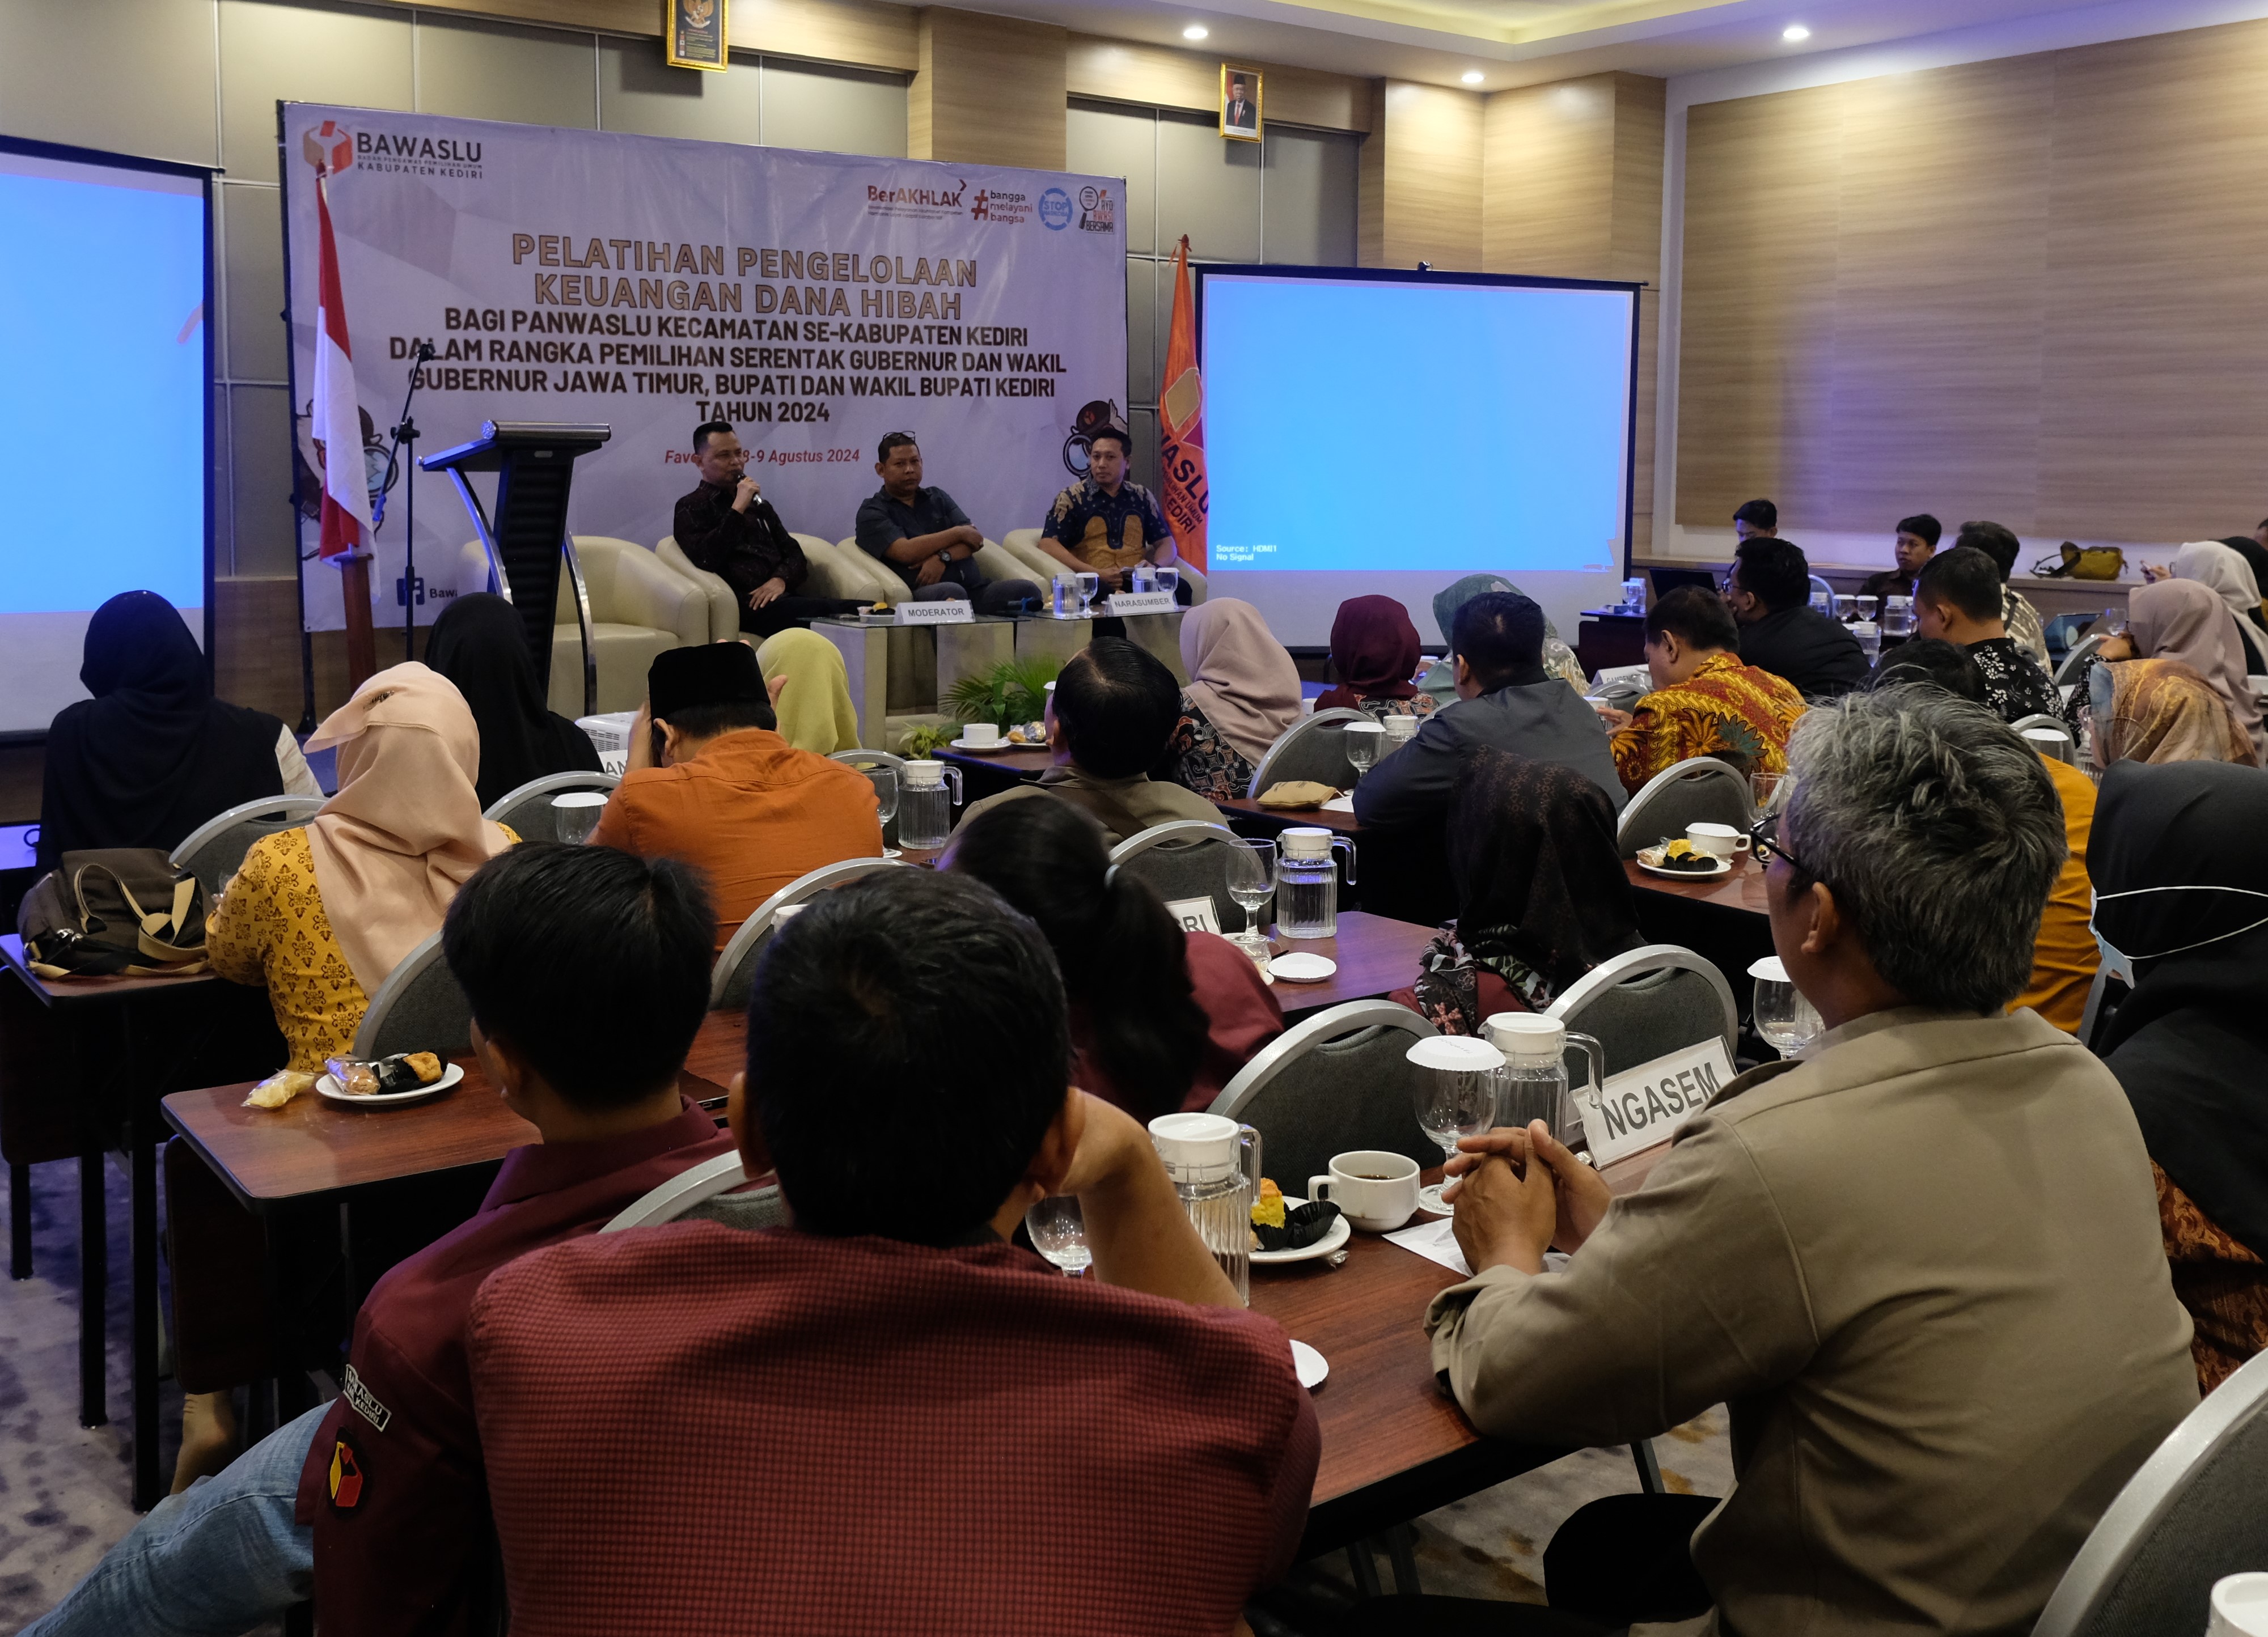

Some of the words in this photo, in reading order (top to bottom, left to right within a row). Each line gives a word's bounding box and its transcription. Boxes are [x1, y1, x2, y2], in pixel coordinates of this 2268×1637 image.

[357, 132, 481, 162] BAWASLU
[358, 162, 435, 175] KABUPATEN
[441, 168, 482, 179] KEDIRI
[868, 185, 962, 207] BerAKHLAK
[991, 190, 1025, 202] bangga
[1044, 201, 1068, 210] STOP
[991, 202, 1033, 214] melayani
[991, 213, 1025, 224] bangsa
[1086, 220, 1113, 232] BERSAMA
[513, 234, 723, 275] PELATIHAN
[738, 247, 976, 287] PENGELOLAAN
[535, 273, 742, 312] KEUANGAN
[755, 285, 850, 316] DANA
[861, 289, 960, 320] HIBAH
[445, 307, 505, 332] BAGI
[512, 310, 651, 337] PANWASLU
[658, 315, 798, 341] KECAMATAN
[803, 321, 962, 346] SE-KABUPATEN
[967, 326, 1027, 346] KEDIRI
[489, 340, 594, 364] RANGKA
[600, 343, 725, 367] PEMILIHAN
[730, 347, 845, 370] SERENTAK
[850, 350, 957, 371] GUBERNUR
[964, 352, 1002, 372] DAN
[1006, 353, 1067, 372] WAKIL
[408, 367, 547, 392] GUBERNUR
[553, 370, 627, 393] JAWA
[633, 372, 709, 397] TIMUR,
[716, 374, 795, 396] BUPATI
[801, 375, 845, 396] DAN
[849, 376, 916, 397] WAKIL
[921, 377, 991, 397] BUPATI
[996, 378, 1055, 397] KEDIRI
[696, 401, 772, 422] TAHUN
[777, 402, 830, 422] 2024
[768, 449, 823, 466] Agustus
[827, 448, 860, 463] 2024
[1185, 501, 1203, 524] UMUM
[1230, 553, 1254, 562] Signal
[908, 608, 964, 617] MODERATOR
[1114, 597, 1171, 608] NARASUMBER
[1601, 1062, 1721, 1140] NGASEM
[355, 1397, 379, 1423] KEDIRI
